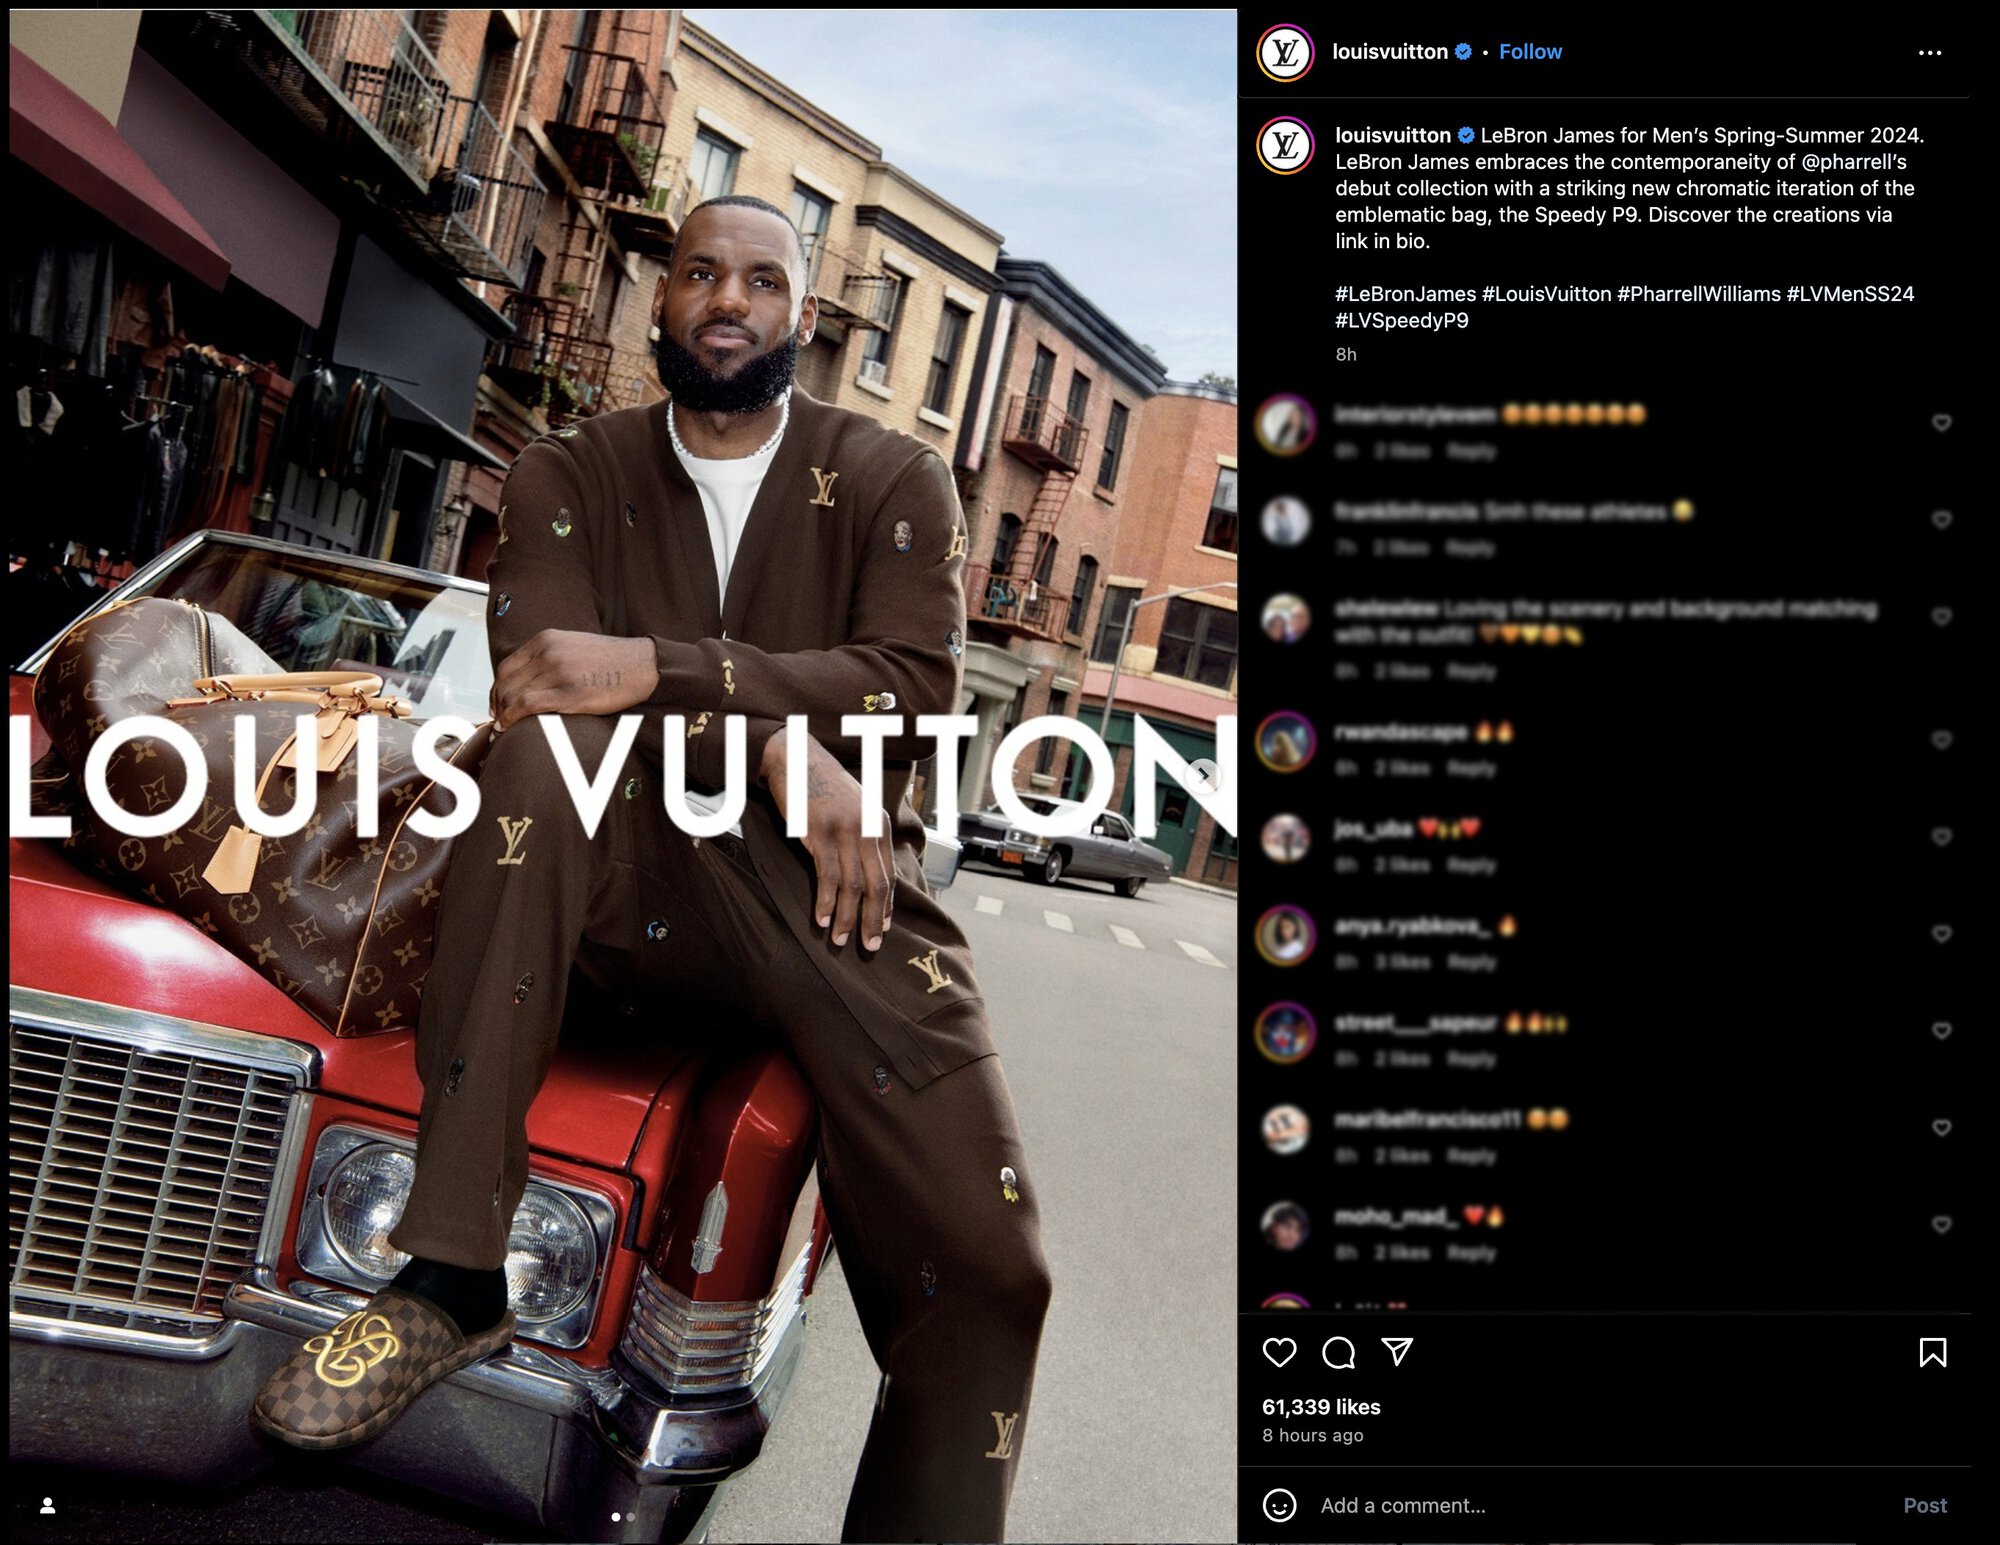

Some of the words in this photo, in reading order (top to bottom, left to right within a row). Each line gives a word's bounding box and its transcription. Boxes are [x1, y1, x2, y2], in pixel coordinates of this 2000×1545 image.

[1333, 41, 1449, 60] louisvuitton
[1499, 42, 1563, 60] Follow
[1336, 125, 1452, 144] louisvuitton
[1481, 127, 1548, 144] LeBron
[1553, 127, 1615, 144] James
[1619, 126, 1648, 144] for
[1714, 126, 1865, 147] Spring-Summer
[1870, 126, 1925, 144] 2024.
[1336, 153, 1402, 170] LeBron
[1407, 153, 1470, 171] James
[1475, 152, 1569, 170] embraces
[1574, 152, 1605, 170] the
[1610, 152, 1772, 174] contemporaneity
[1776, 152, 1797, 170] of
[1335, 179, 1392, 197] debut
[1396, 179, 1488, 197] collection
[1493, 179, 1534, 197] with
[1539, 183, 1550, 197] a
[1556, 179, 1626, 200] striking
[1632, 183, 1671, 197] new
[1676, 179, 1771, 197] chromatic
[1776, 179, 1854, 197] iteration
[1859, 179, 1880, 197] of
[1884, 179, 1915, 197] the
[1335, 205, 1446, 223] emblematic
[1451, 205, 1492, 227] bag,
[1498, 205, 1530, 223] the
[1535, 205, 1607, 227] Speedy
[1612, 205, 1642, 223] P9.
[1649, 205, 1732, 223] Discover
[1736, 205, 1768, 223] the
[1772, 205, 1861, 223] creations
[1865, 205, 1893, 223] via
[1336, 232, 1369, 249] link
[1374, 232, 1390, 249] in
[1396, 232, 1430, 250] bio.
[1334, 285, 1477, 303] #LeBronJames
[1481, 284, 1612, 302] #LouisVuitton
[1616, 284, 1782, 302] #PharrellWilliams
[1786, 285, 1915, 303] #LVMenSS24
[1334, 311, 1469, 332] #LVSpeedyP9
[1335, 346, 1357, 362] 8h
[1447, 443, 1496, 461] Reply
[1447, 540, 1496, 558] Reply
[1512, 600, 1543, 618] the
[1549, 603, 1623, 622] scenery
[1631, 600, 1665, 618] and
[1670, 600, 1783, 622] background
[1789, 600, 1877, 622] matching
[1336, 626, 1375, 643] with
[1381, 626, 1411, 643] the
[1447, 663, 1496, 681] Reply
[1447, 760, 1496, 778] Reply
[1447, 857, 1496, 875] Reply
[1447, 954, 1496, 972] Reply
[1447, 1051, 1496, 1069] Reply
[1447, 1148, 1496, 1166] Reply
[1447, 1245, 1496, 1263] Reply
[1262, 1398, 1331, 1419] 61,339
[1336, 1397, 1382, 1416] likes
[1262, 1428, 1273, 1443] 8
[1279, 1427, 1327, 1443] hours
[1332, 1431, 1364, 1446] ago
[1320, 1496, 1359, 1514] Add
[1364, 1500, 1375, 1514] a
[1904, 1497, 1948, 1514] Post
